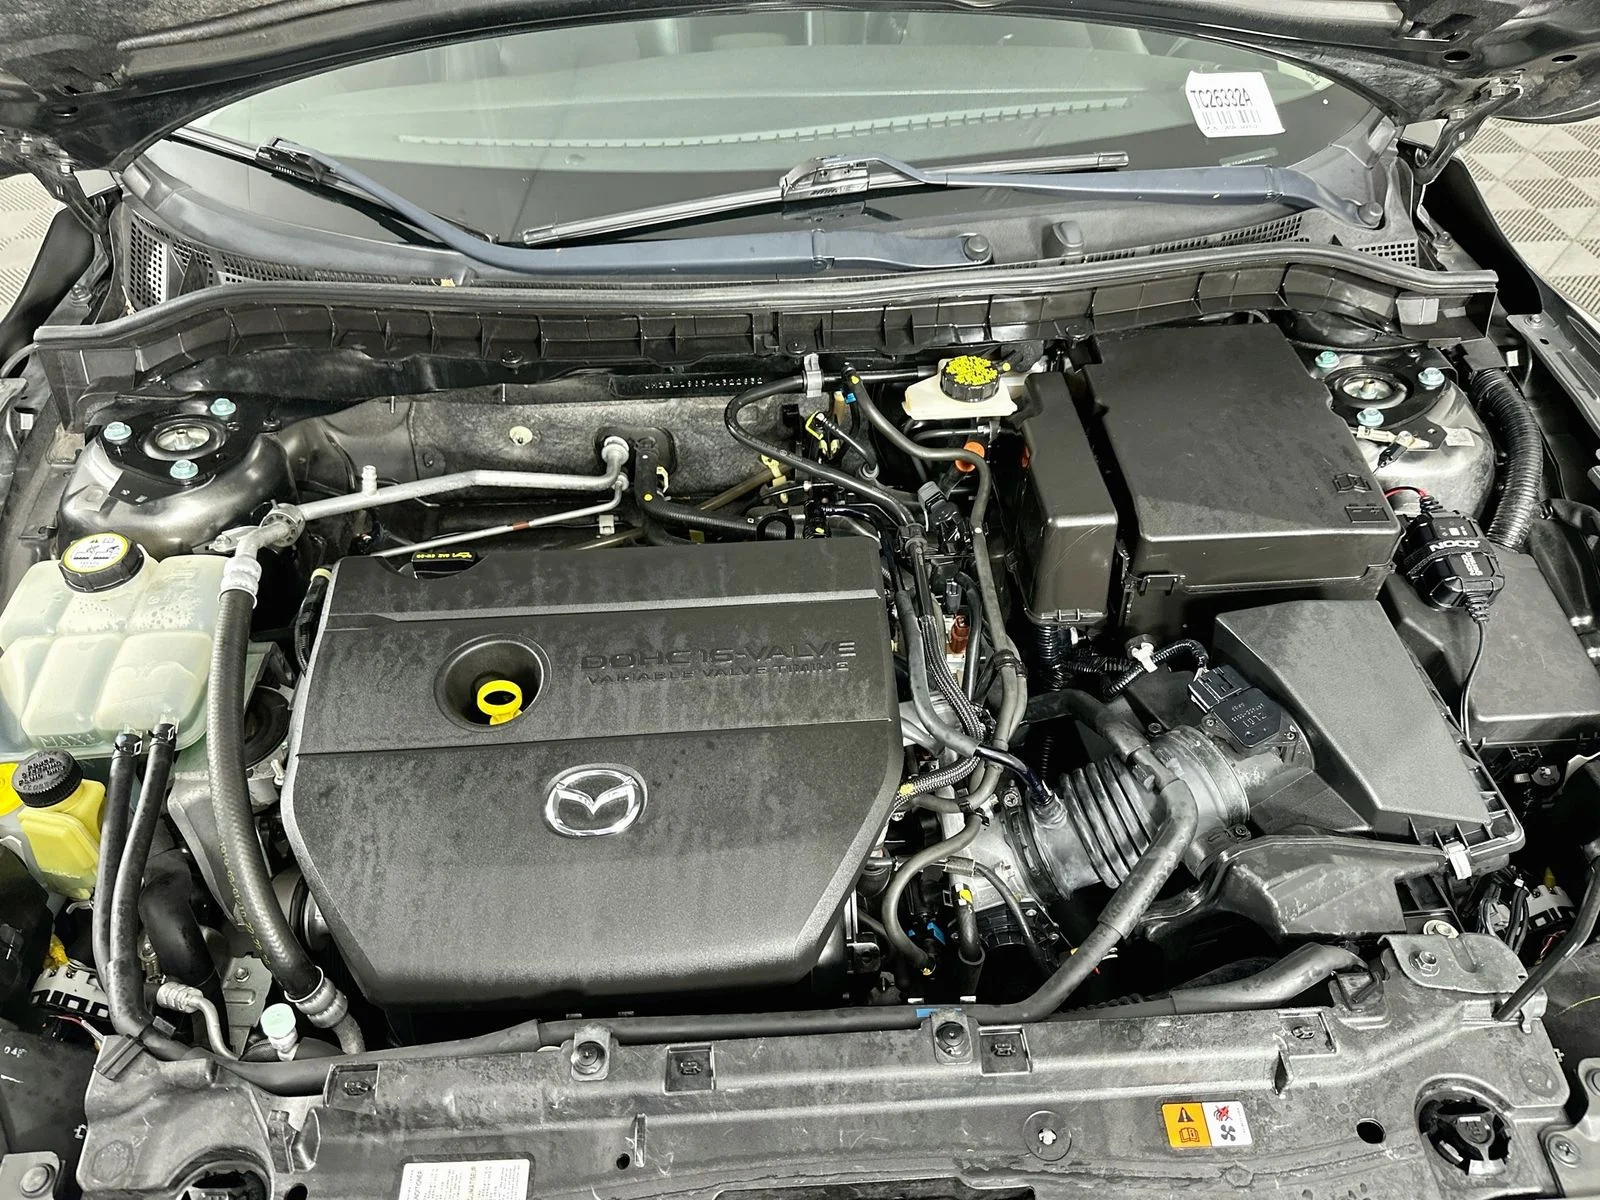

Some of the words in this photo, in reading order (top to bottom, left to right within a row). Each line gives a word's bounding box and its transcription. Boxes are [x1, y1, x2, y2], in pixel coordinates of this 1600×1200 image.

[1190, 87, 1253, 109] TC26332A
[1428, 539, 1481, 552] NOCO
[580, 649, 692, 670] DOHC
[585, 670, 695, 686] VARIABLE
[702, 665, 768, 678] VALVE
[775, 660, 850, 675] TIMING
